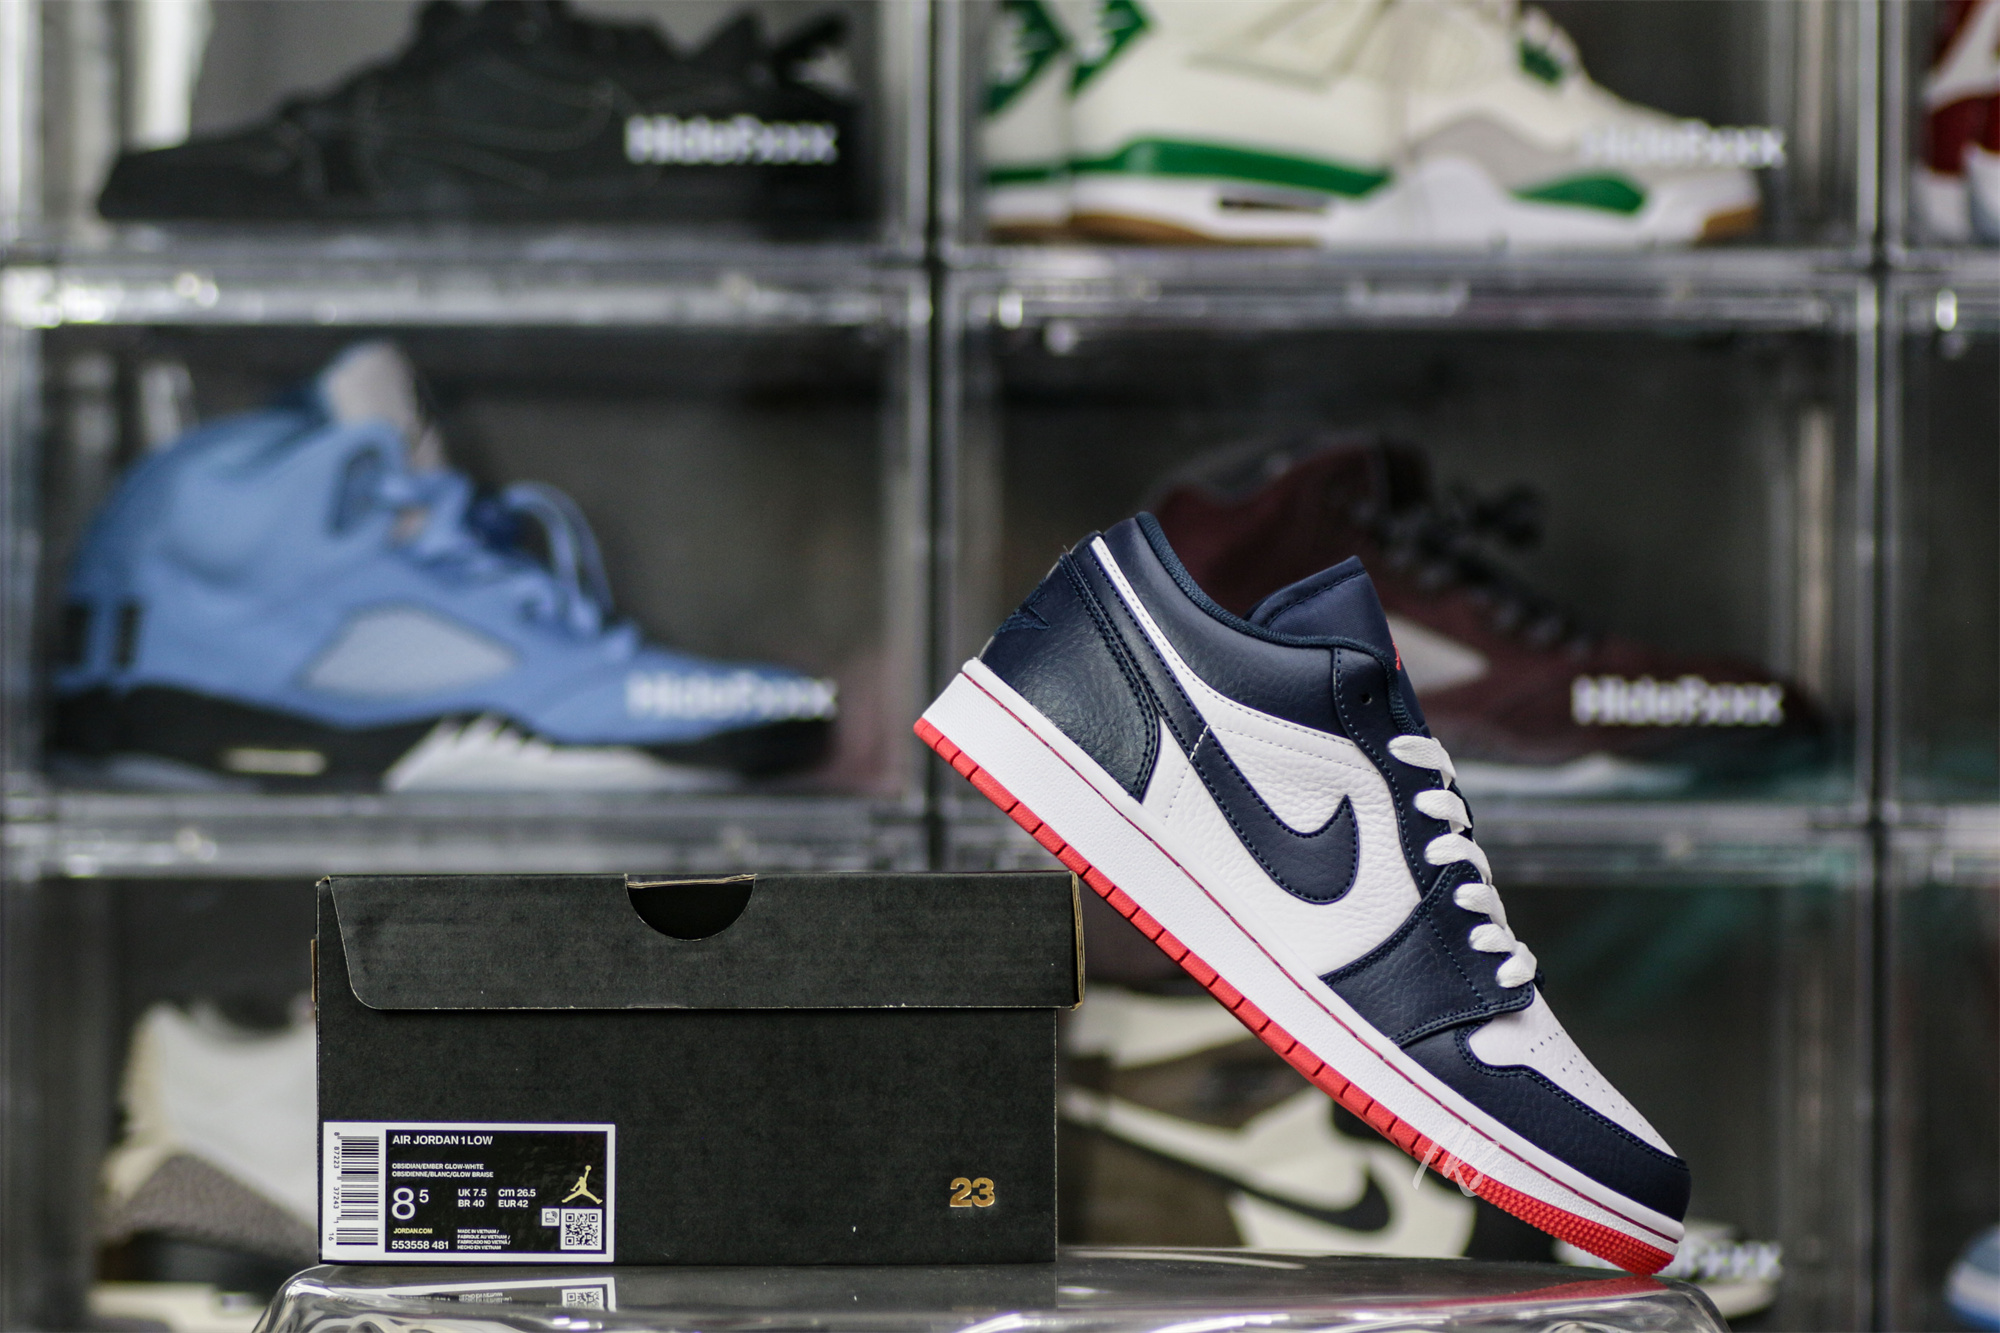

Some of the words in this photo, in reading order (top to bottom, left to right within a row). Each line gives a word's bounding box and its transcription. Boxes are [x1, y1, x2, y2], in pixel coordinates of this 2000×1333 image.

[392, 1135, 411, 1145] AIR
[413, 1135, 459, 1145] JORDAN
[461, 1135, 466, 1145] 1
[467, 1135, 494, 1145] LOW
[458, 1188, 471, 1197] UK
[472, 1188, 487, 1197] 7.5
[516, 1188, 537, 1197] 26.5
[949, 1177, 996, 1208] 23
[391, 1187, 416, 1220] 8
[419, 1189, 430, 1204] 5
[458, 1199, 471, 1208] BR
[472, 1199, 485, 1208] 40
[498, 1199, 516, 1208] EUR
[516, 1199, 529, 1208] 42
[328, 1233, 334, 1241] 16
[391, 1240, 430, 1250] 553558
[431, 1240, 449, 1250] 481
